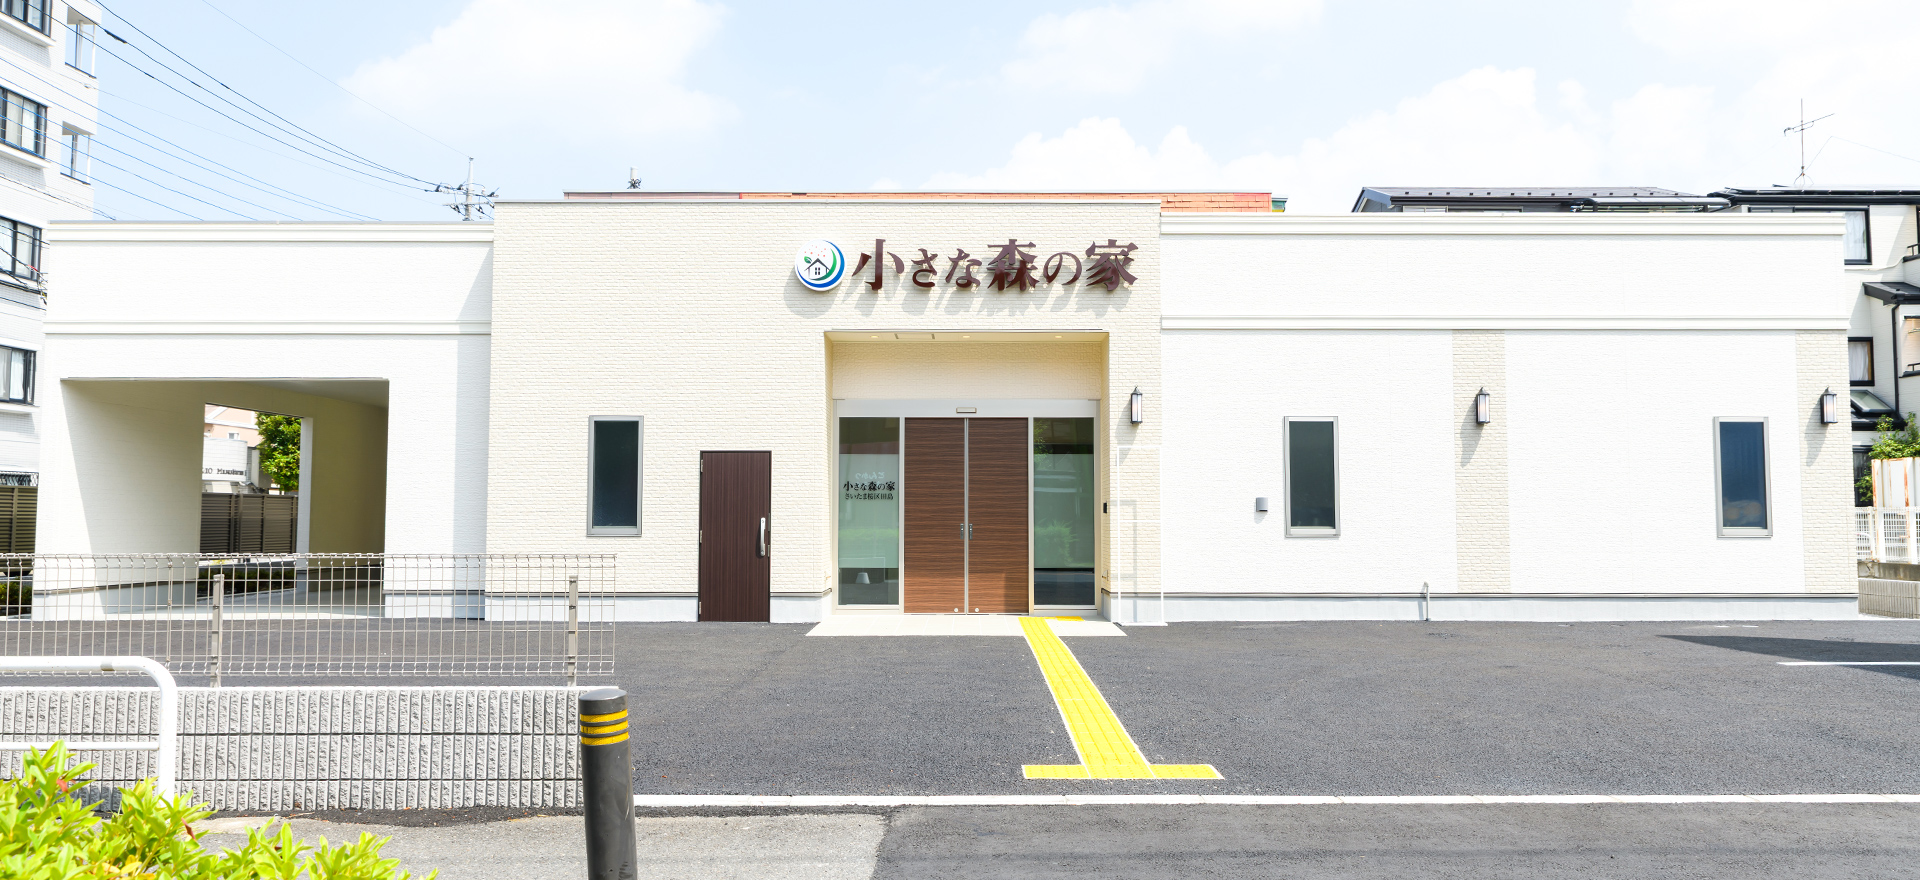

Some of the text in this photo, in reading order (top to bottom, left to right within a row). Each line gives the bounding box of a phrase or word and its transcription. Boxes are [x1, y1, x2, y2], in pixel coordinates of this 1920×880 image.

[851, 238, 1138, 291] 小さな森の家
[843, 480, 896, 492] 小さな森の家
[845, 492, 894, 500] さいたま桜区田島
